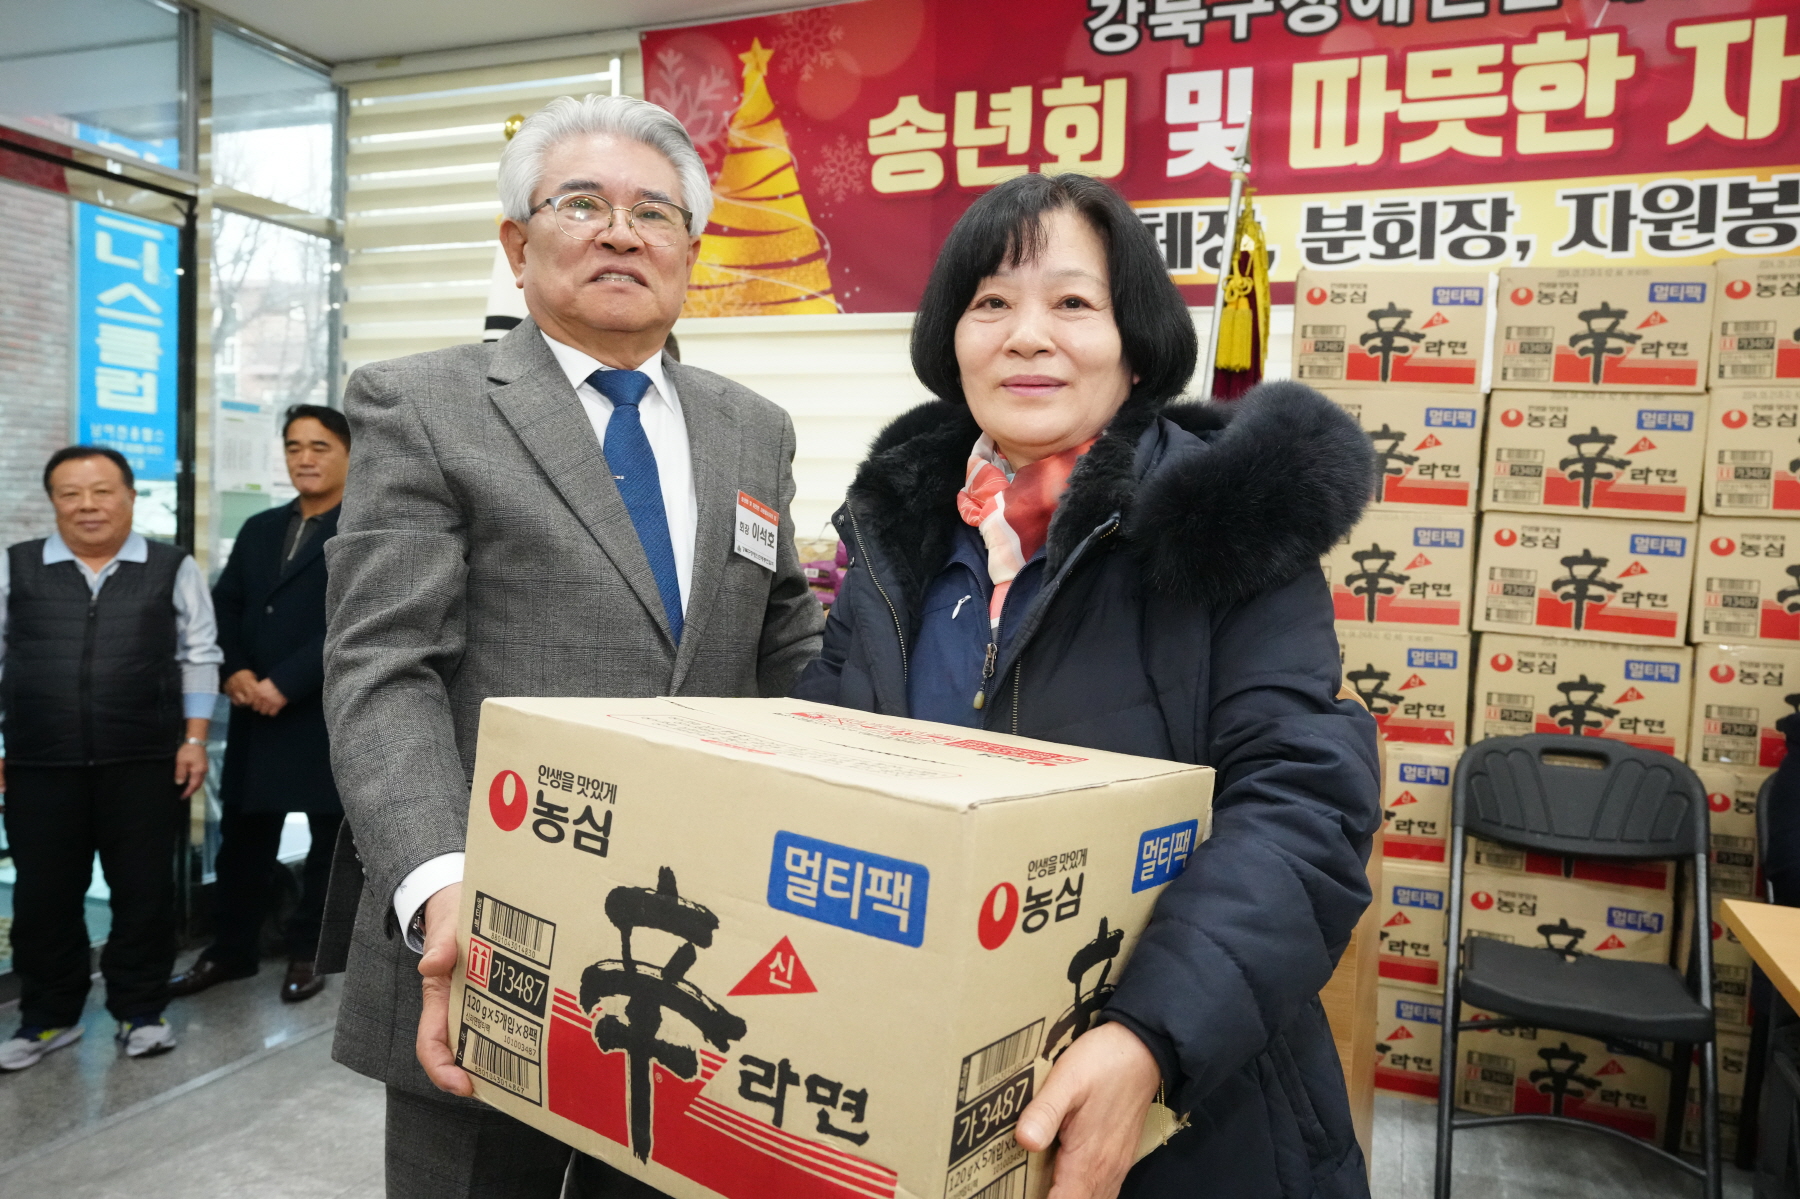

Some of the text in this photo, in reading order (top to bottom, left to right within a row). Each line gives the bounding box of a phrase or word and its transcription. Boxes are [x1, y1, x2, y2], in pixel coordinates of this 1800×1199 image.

[868, 76, 1128, 194] 송년회
[1166, 67, 1254, 177] 및
[1289, 30, 1636, 169] 따뜻한
[1301, 197, 1531, 264] 분회장,
[1558, 180, 1800, 252] 자원봉
[1330, 290, 1367, 304] 농심
[1436, 288, 1480, 304] 멀티팩
[1537, 290, 1578, 305] 농심
[1653, 284, 1702, 302] 멀티팩
[95, 213, 165, 415] 니스클럽
[1360, 302, 1426, 382] 辛
[1425, 340, 1467, 356] 라면
[1569, 302, 1643, 385] 辛
[1640, 341, 1689, 358] 라면
[1429, 410, 1472, 426] 멀티팩
[1528, 413, 1567, 428] 농심
[1641, 412, 1690, 430] 멀티팩
[1753, 412, 1797, 428] 농심
[1418, 463, 1461, 479] 라면
[1559, 426, 1632, 509] 辛
[1630, 467, 1678, 484] 라면
[739, 521, 775, 549] 회장 이석호
[1417, 529, 1460, 546] 멀티팩
[1520, 533, 1560, 549] 농심
[1634, 537, 1682, 555] 멀티팩
[1740, 542, 1785, 558] 농심
[1344, 543, 1411, 624] 辛
[1410, 582, 1452, 599] 라면
[1552, 548, 1623, 631] 辛
[1621, 591, 1668, 608] 라면
[1411, 651, 1454, 667] 멀티팩
[1517, 659, 1557, 674] 농심
[1629, 663, 1677, 681] 멀티팩
[1739, 669, 1783, 686] 농심
[1404, 702, 1446, 719] 라면
[1619, 717, 1666, 734] 라면
[1403, 766, 1446, 783] 멀티팩
[538, 765, 617, 804] 인생을 맛있게
[532, 789, 612, 858] 농심
[1395, 818, 1437, 835] 라면
[1140, 828, 1192, 882] 멀티팩
[1028, 848, 1088, 881] 인생을 맛있게
[784, 846, 913, 933] 멀티팩
[1397, 888, 1440, 907] 멀티팩
[1022, 872, 1084, 934] 농심
[1497, 899, 1537, 916] 농심
[1612, 909, 1660, 931] 멀티팩
[1388, 939, 1431, 957] 라면
[768, 951, 796, 990] 신
[492, 959, 546, 1007] 가3487
[579, 866, 748, 1165] 辛
[504, 1035, 537, 1057] 101003487
[1390, 1053, 1433, 1072] 라면
[738, 1054, 870, 1146] 라면
[957, 1077, 1029, 1148] 가3487
